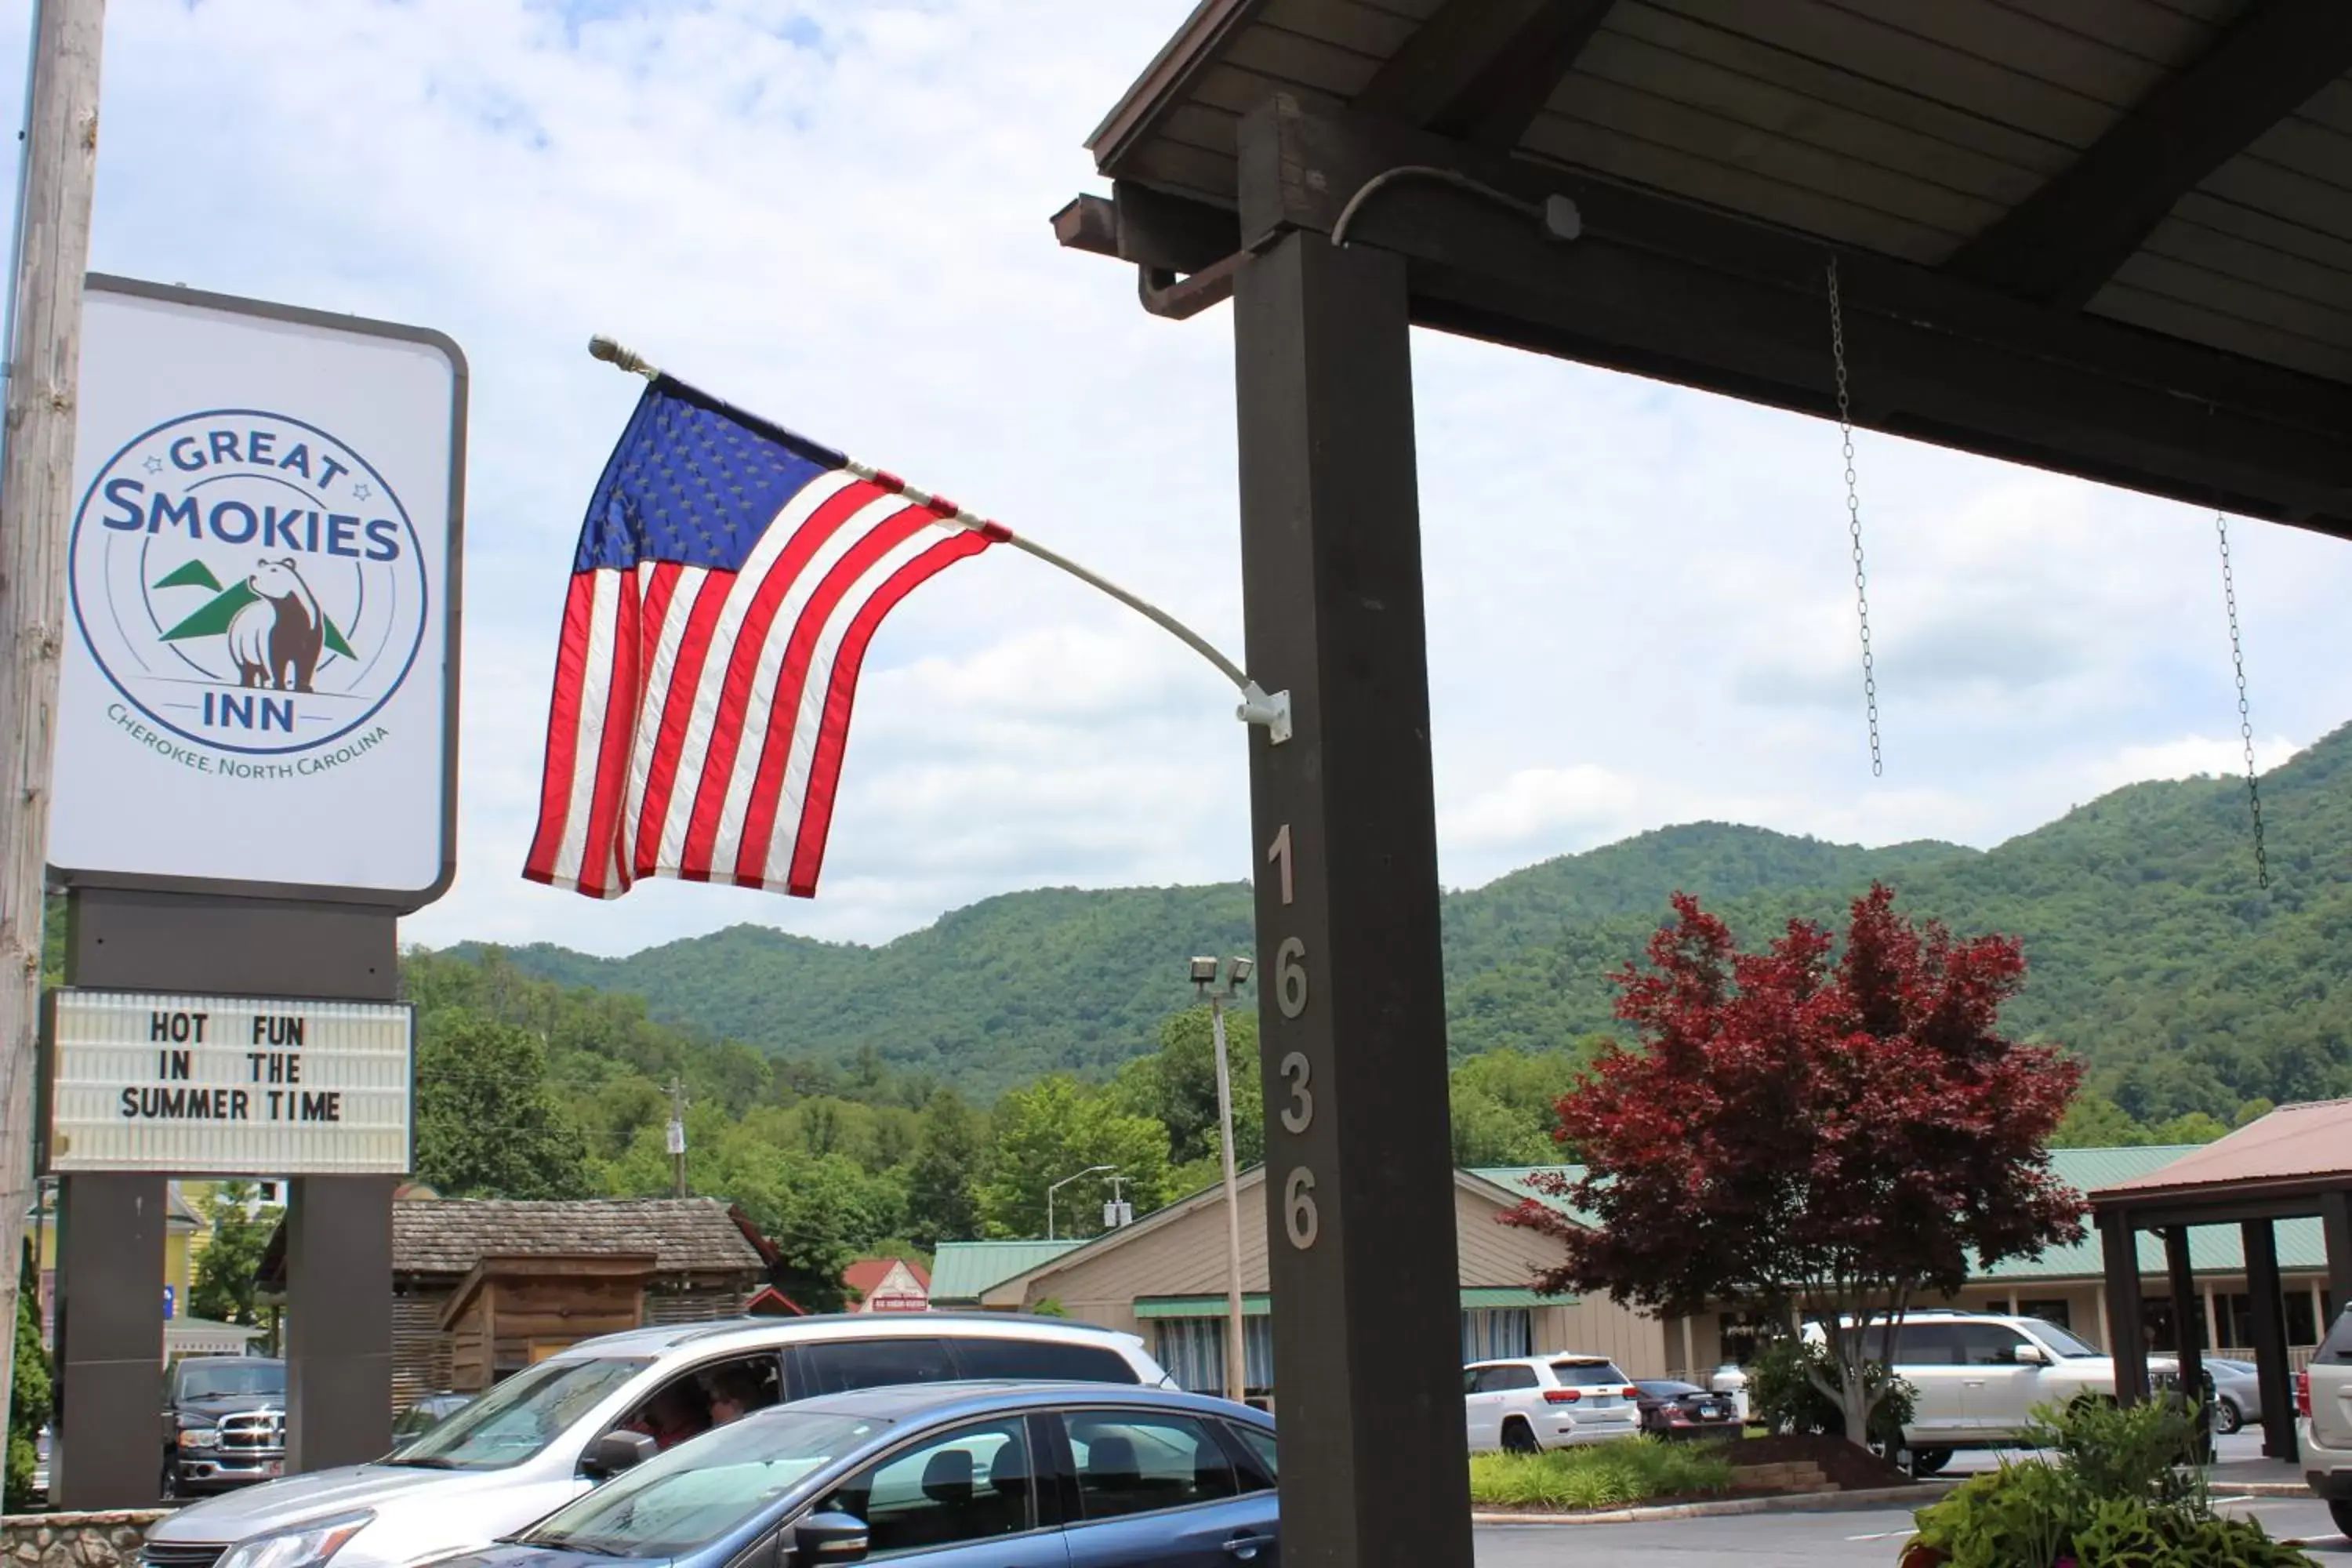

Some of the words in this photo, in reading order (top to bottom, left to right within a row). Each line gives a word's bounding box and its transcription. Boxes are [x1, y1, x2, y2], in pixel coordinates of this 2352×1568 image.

[169, 430, 350, 489] GREAT
[103, 478, 400, 561] SMOKIES
[204, 692, 294, 732] INN
[107, 703, 213, 773] CHEROKEE,
[219, 758, 293, 779] NORTH
[297, 726, 389, 775] CAROLINA
[151, 1011, 208, 1044] HOT
[252, 1016, 304, 1046] FUN
[1268, 824, 1319, 1250] 1636
[160, 1051, 190, 1080] IN
[248, 1053, 300, 1083] THE
[122, 1087, 248, 1120] SUMMER
[268, 1091, 340, 1121] TIME
